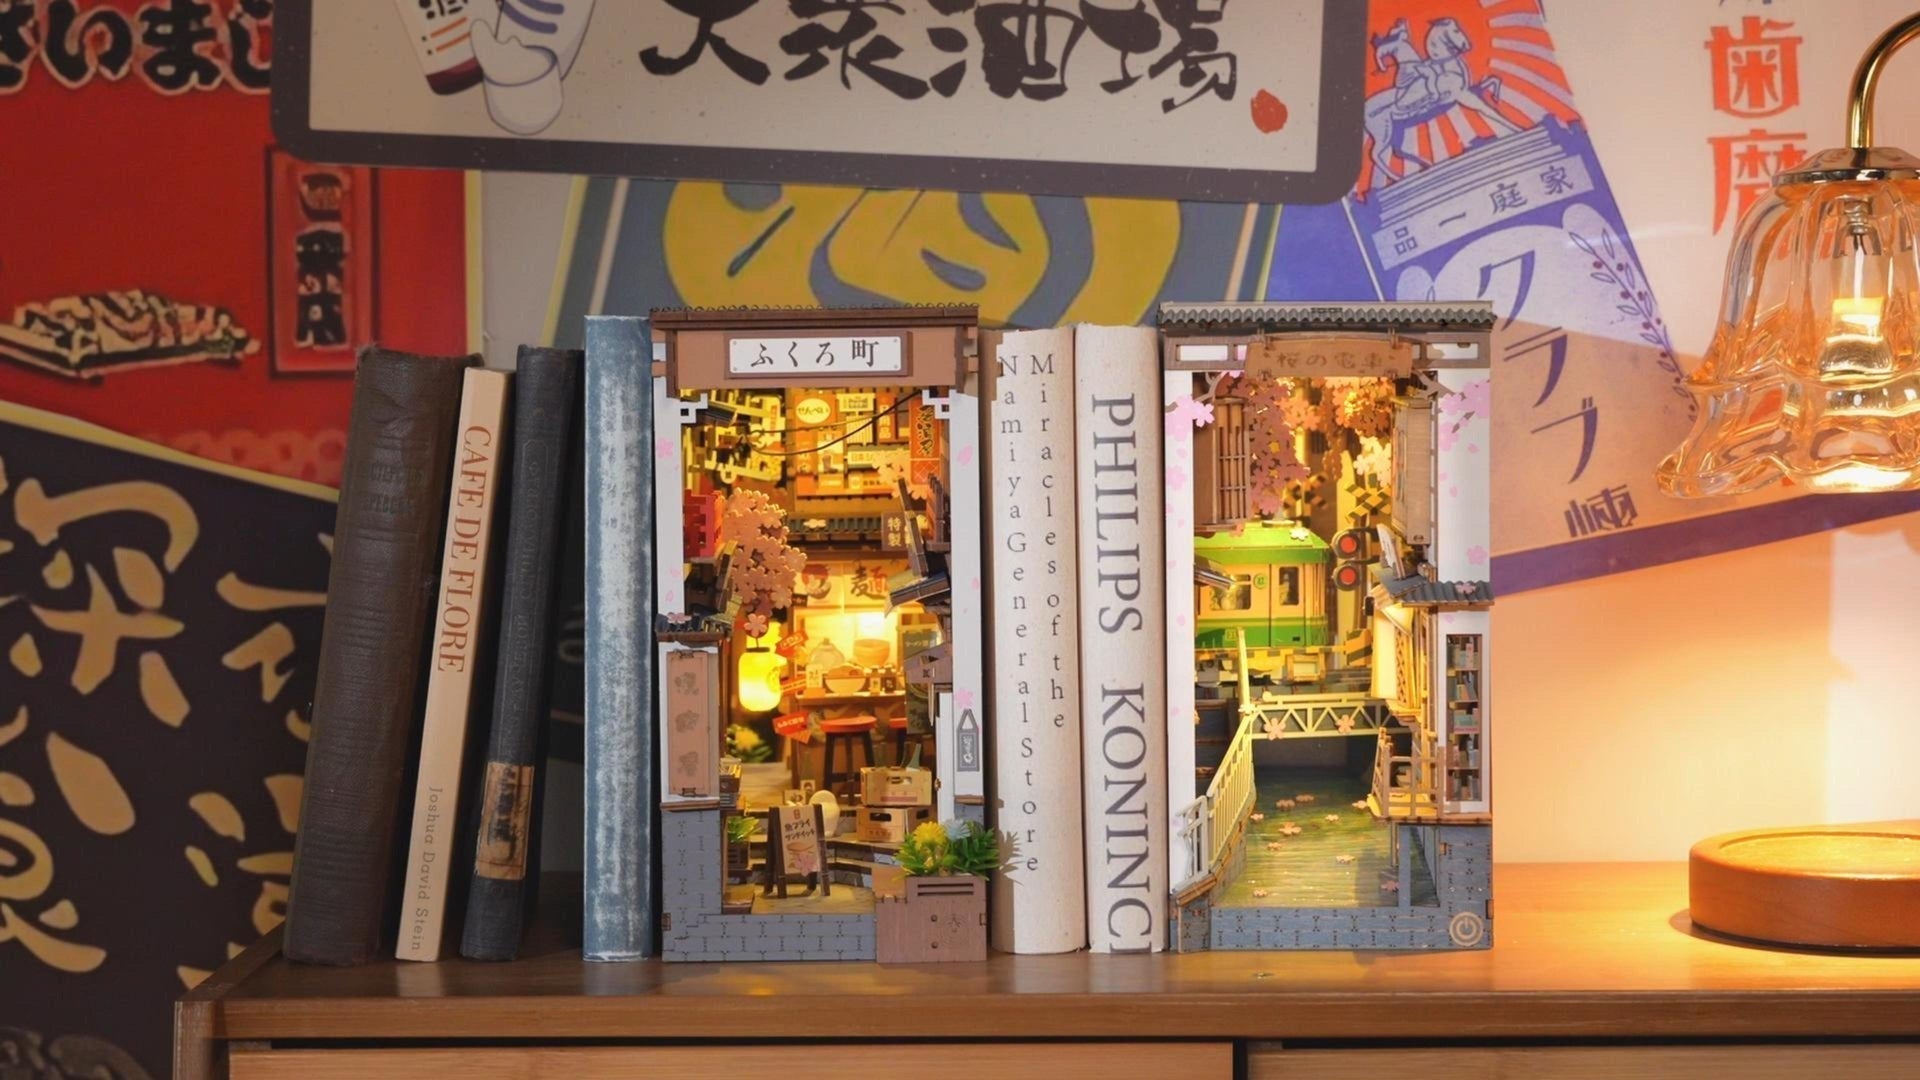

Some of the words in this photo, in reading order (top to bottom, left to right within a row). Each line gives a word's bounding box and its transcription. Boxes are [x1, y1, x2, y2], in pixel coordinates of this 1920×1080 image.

[750, 339, 879, 368] ふくろ町
[1277, 351, 1383, 370] 桜の電車
[457, 425, 492, 508] CAFE
[1000, 355, 1023, 519] Namiya
[1031, 354, 1057, 575] Miracles
[451, 516, 481, 561] DE
[1091, 393, 1143, 635] PHILIPS
[437, 570, 475, 674] FLORE
[1007, 531, 1030, 723] General
[1047, 593, 1062, 636] of
[1051, 653, 1065, 728] the
[424, 786, 443, 846] Joshua
[1020, 737, 1039, 871] Store
[1101, 683, 1152, 954] KONINC
[417, 851, 436, 900] David
[411, 907, 430, 951] Stein
